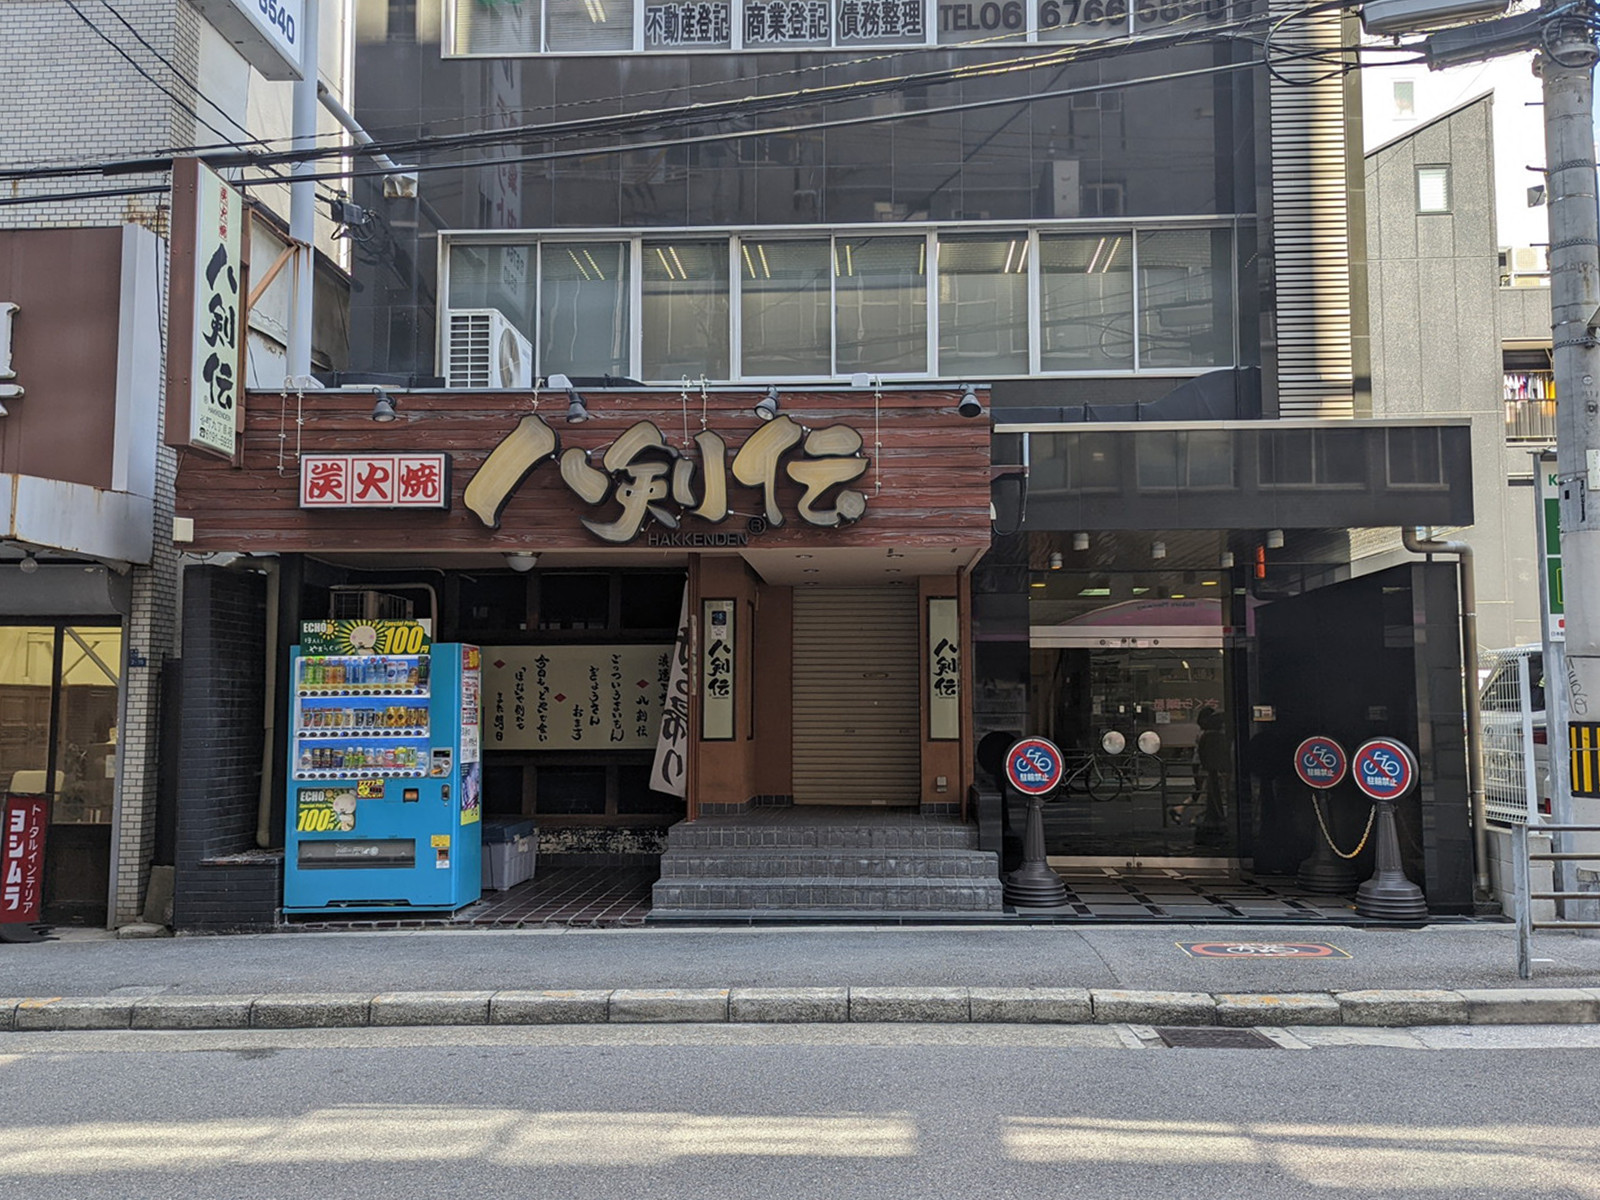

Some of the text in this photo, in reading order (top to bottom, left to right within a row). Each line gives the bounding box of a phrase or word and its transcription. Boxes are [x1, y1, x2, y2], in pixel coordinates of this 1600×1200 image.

[646, 3, 730, 45] 不動産登記
[746, 1, 829, 42] 商業登記
[839, 0, 923, 38] 債務整理
[202, 243, 238, 409] 八剣伝
[308, 462, 438, 501] 炭火焼
[463, 413, 871, 544] 八剣伝
[648, 532, 749, 546] HAKKENDEN
[303, 622, 327, 634] ECHO
[708, 639, 731, 696] 八剣伝
[933, 638, 958, 696] 八剣伝
[589, 665, 600, 727] ぎょうさん
[636, 695, 649, 737] 八剣伝
[571, 704, 584, 741] おます
[1019, 772, 1050, 782] 駐輪禁止
[1307, 768, 1335, 778] 駐輪禁止
[1366, 776, 1398, 787] 駐輪禁止
[300, 791, 325, 802] ECHO
[4, 809, 26, 911] ヨシムラ
[23, 803, 42, 914] トータルインテリア
